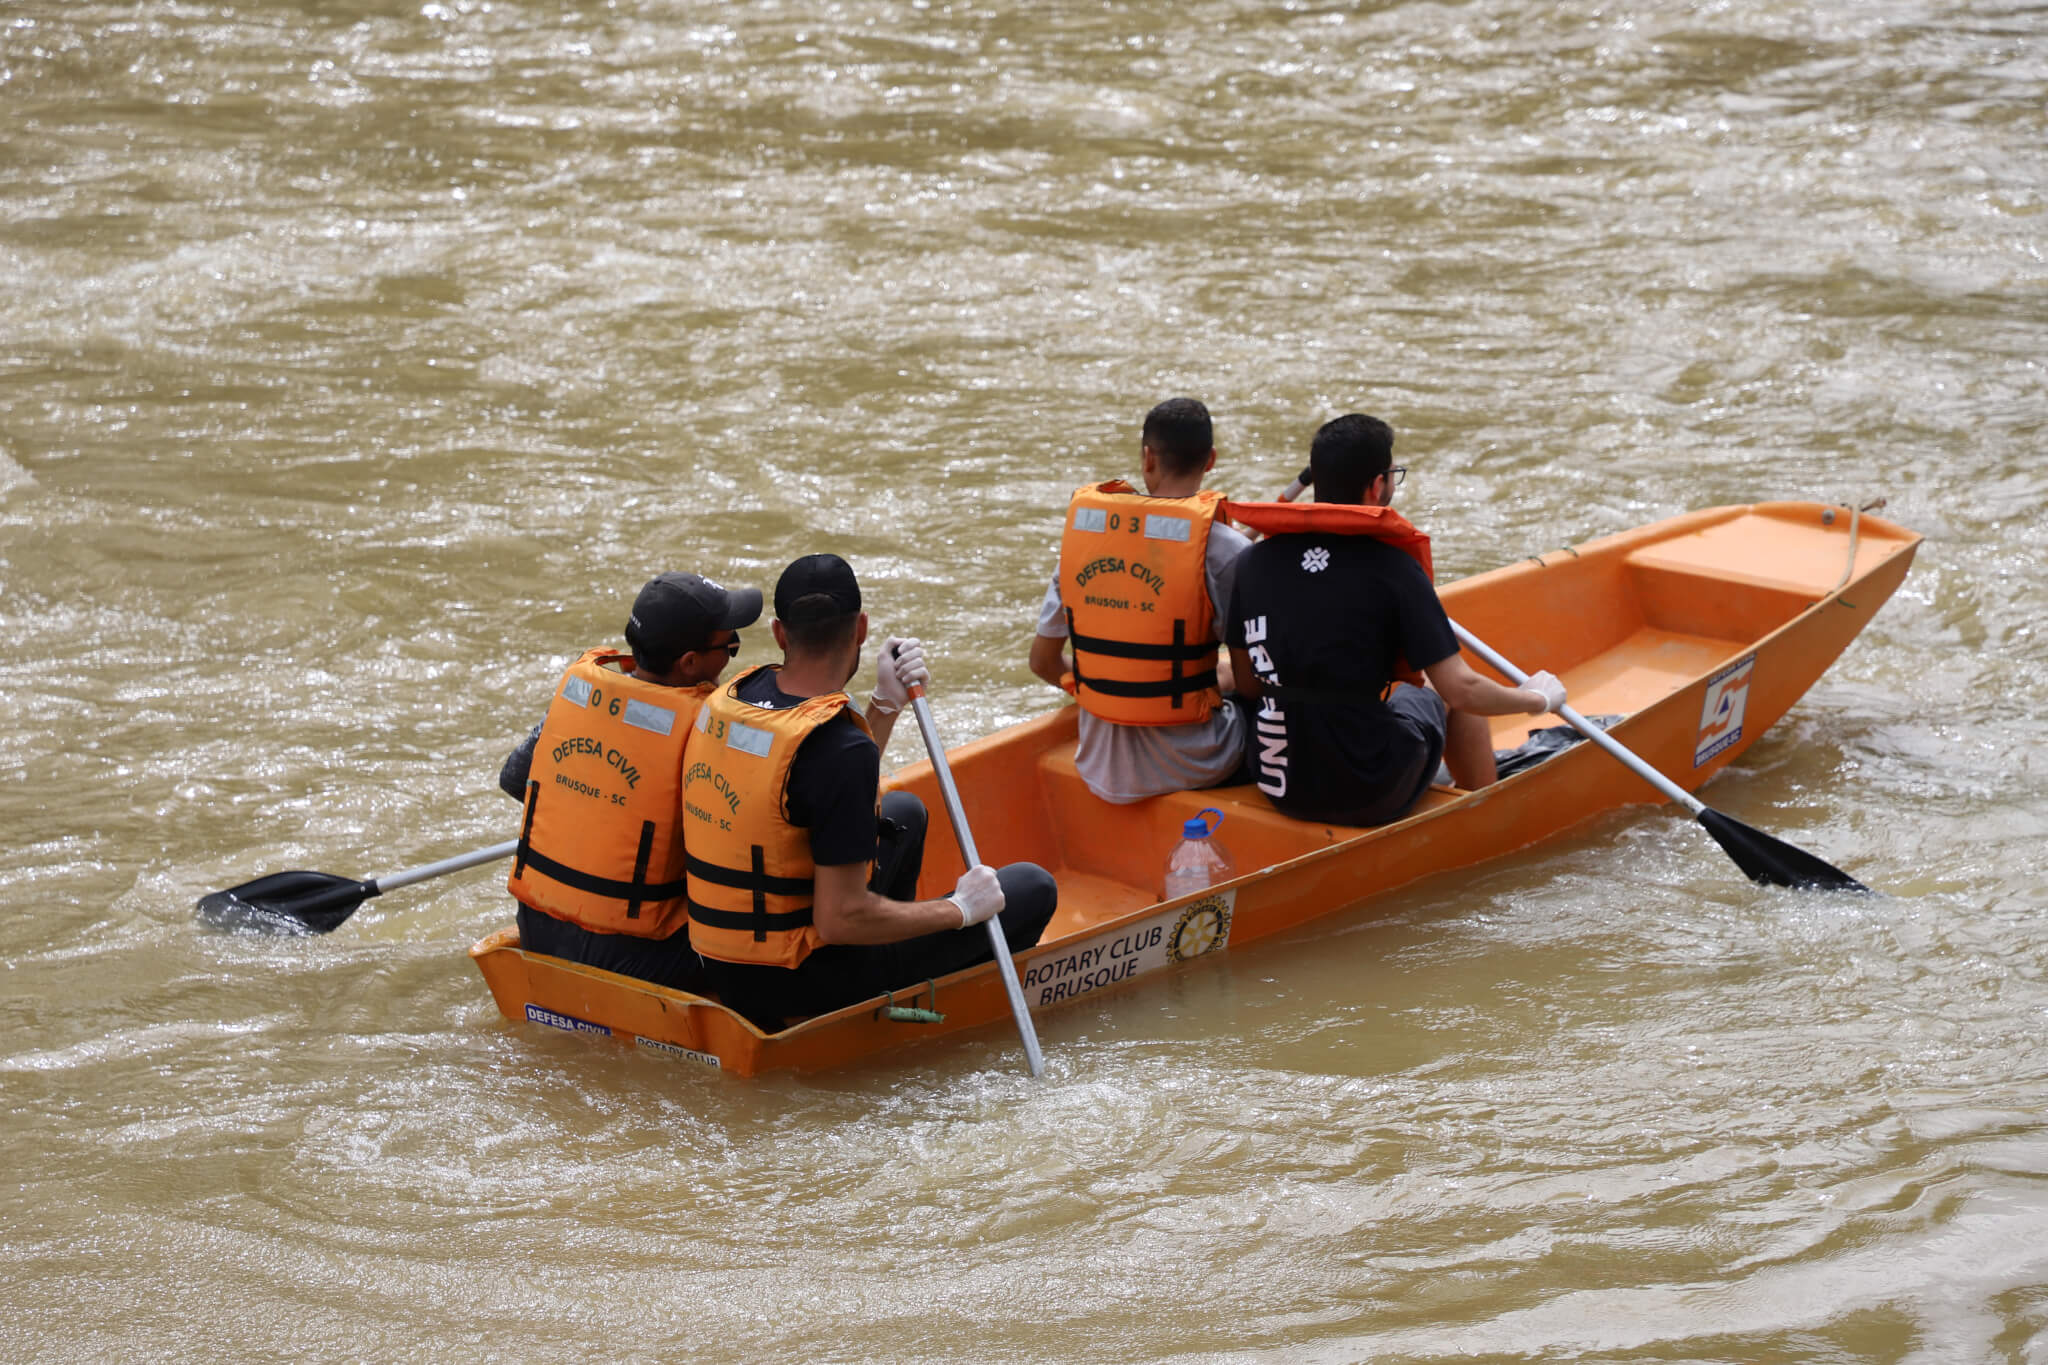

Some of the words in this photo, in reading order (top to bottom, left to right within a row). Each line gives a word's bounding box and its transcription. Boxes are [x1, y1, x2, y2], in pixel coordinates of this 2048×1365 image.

[1076, 558, 1126, 587] DEFESA
[1130, 563, 1165, 596] CIVIL
[1085, 596, 1129, 609] BRUSQUE
[1140, 602, 1155, 612] SC
[552, 738, 602, 763] DEFESA
[607, 749, 641, 790] CIVIL
[556, 774, 600, 798] BRUSQUE
[611, 793, 627, 806] SC
[714, 773, 741, 815] CIVIL
[720, 819, 732, 832] SC
[1024, 945, 1106, 990] ROTARY
[1110, 926, 1162, 960] CLUB
[1040, 957, 1138, 1006] BRUSQUE
[527, 1008, 574, 1029] DEFESA
